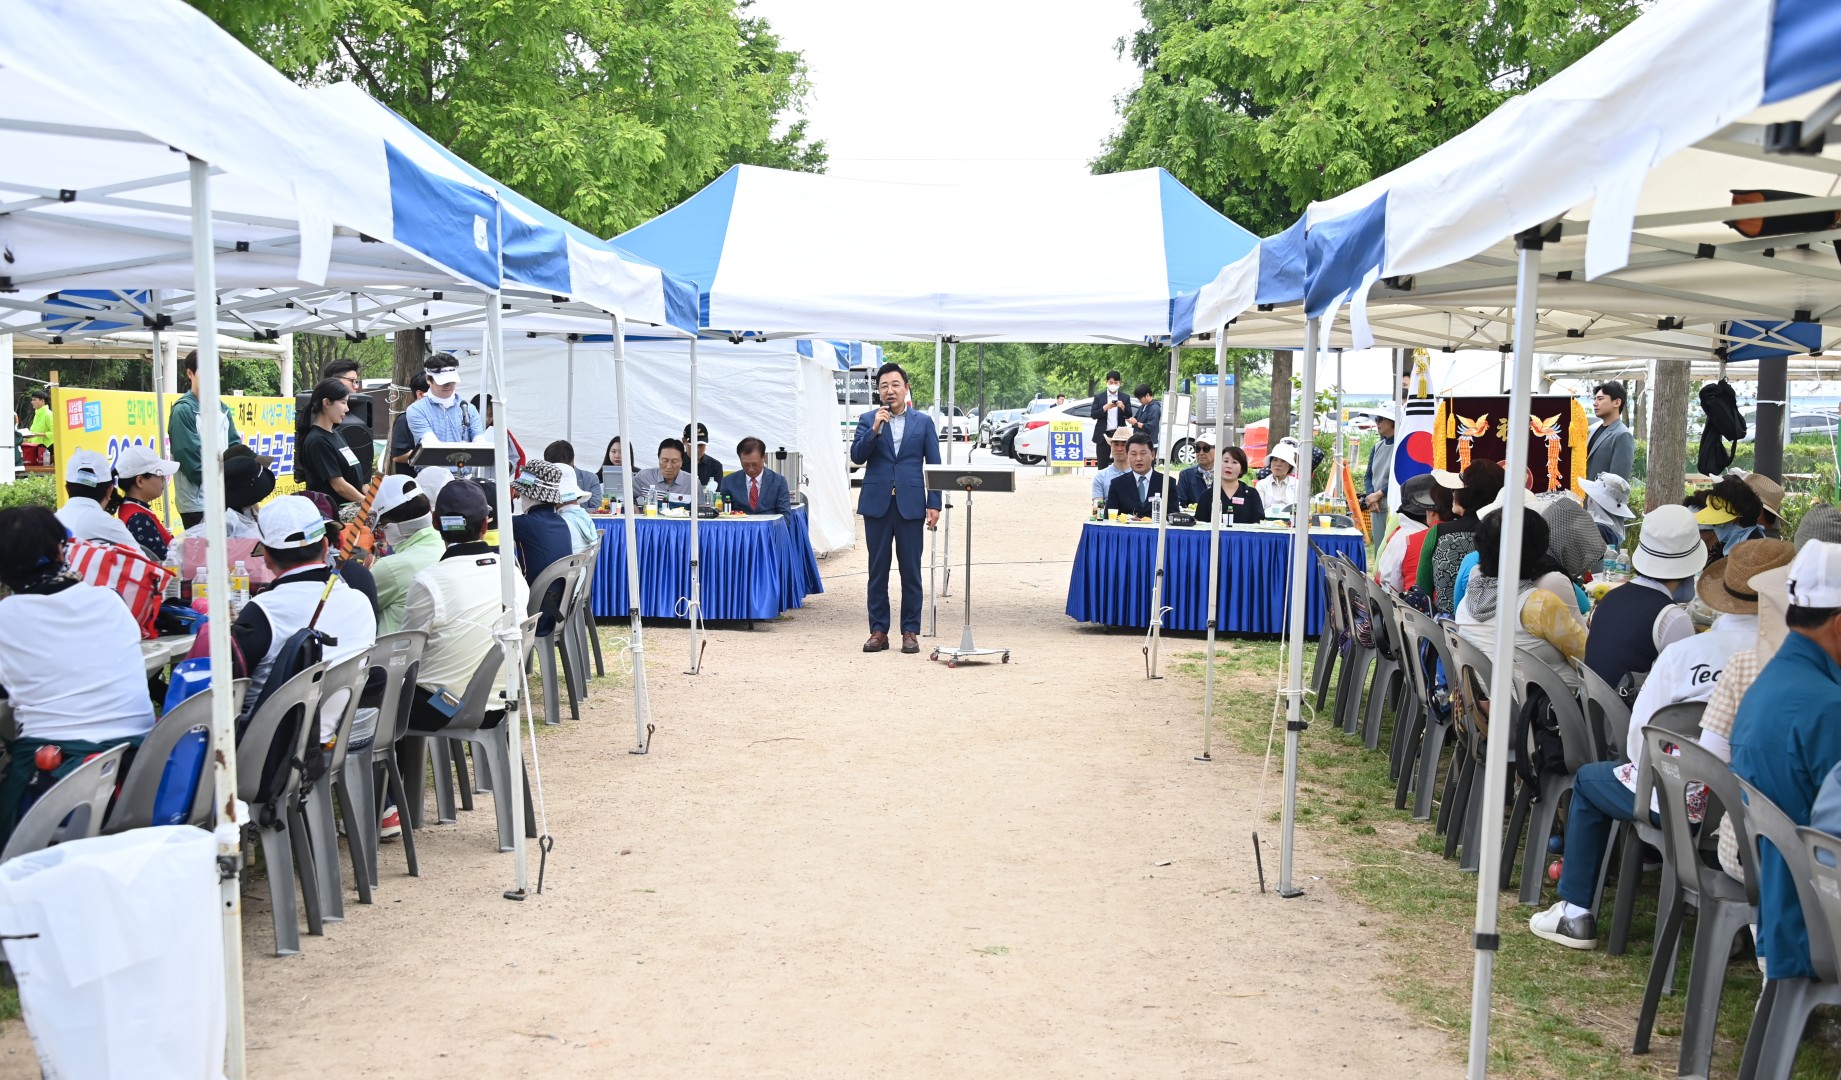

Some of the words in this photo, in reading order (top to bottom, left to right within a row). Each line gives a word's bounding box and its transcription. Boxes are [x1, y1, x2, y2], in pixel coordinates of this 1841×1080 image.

[127, 398, 159, 425] 함께하
[239, 402, 257, 427] 체육!
[262, 403, 282, 427] 사상구
[1054, 433, 1080, 446] 임시
[1055, 447, 1081, 459] 휴장
